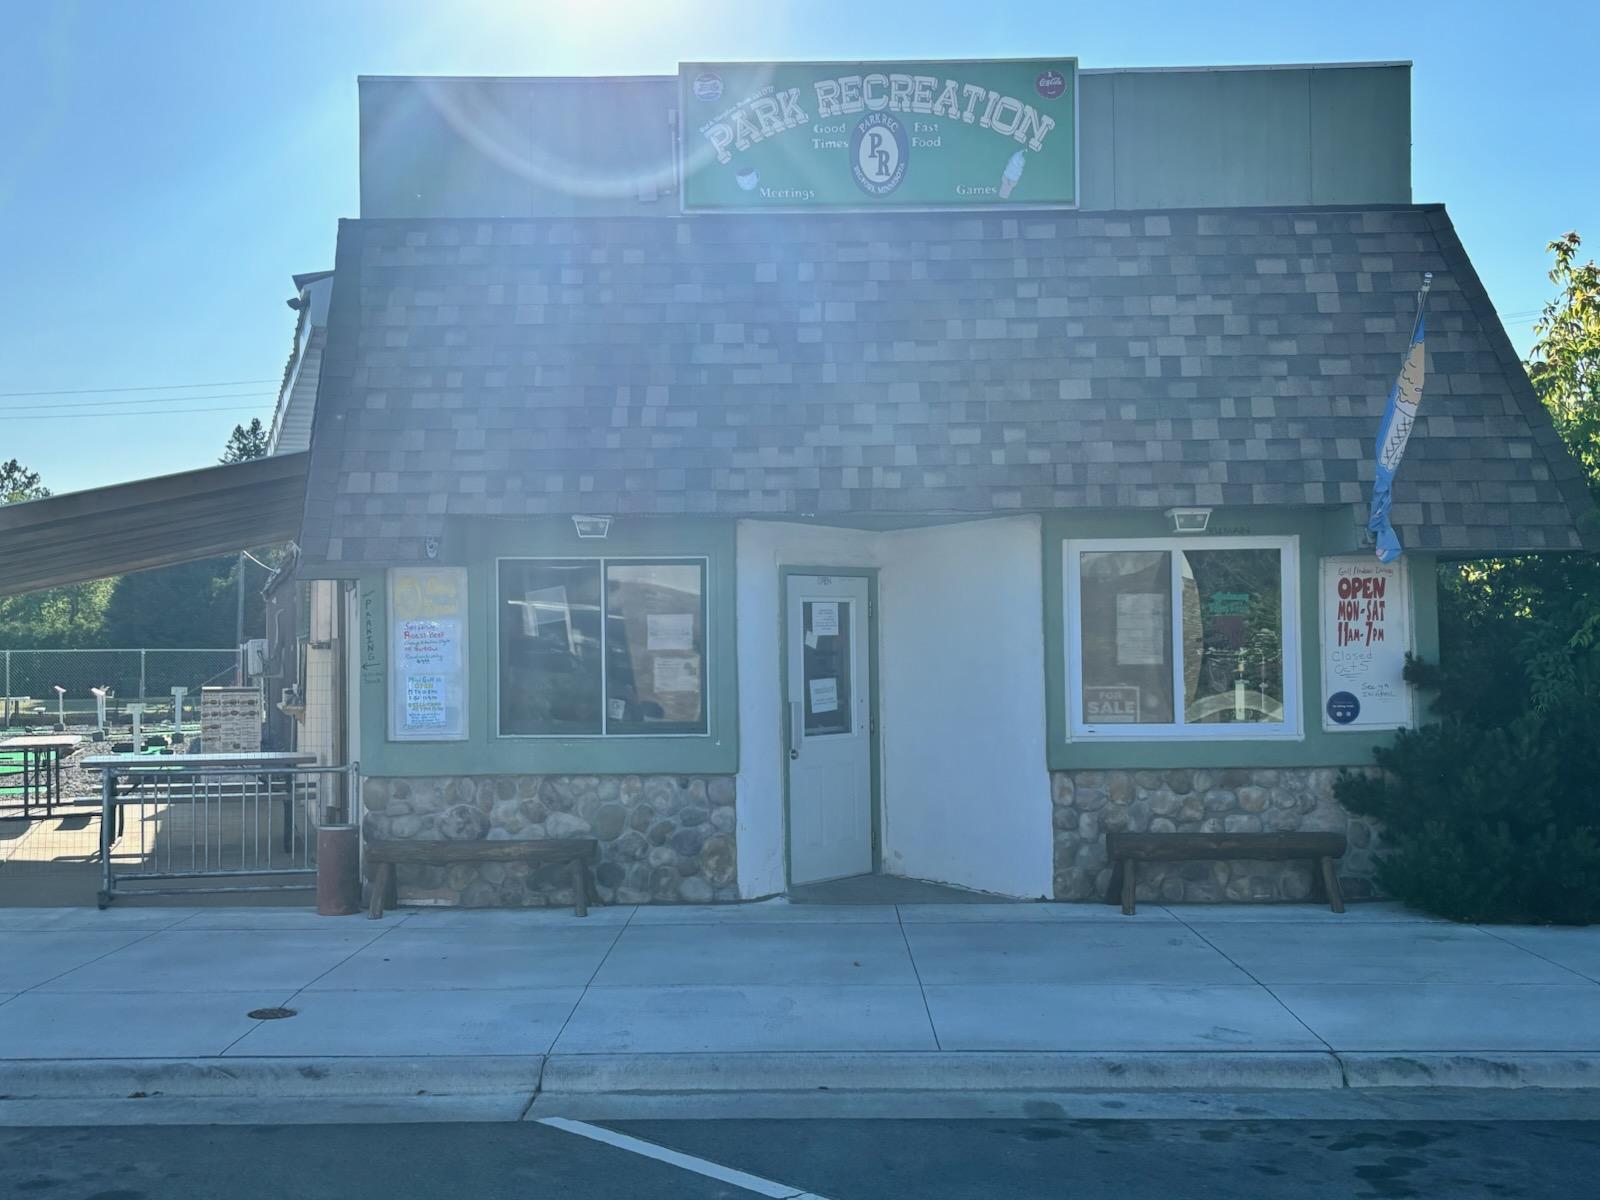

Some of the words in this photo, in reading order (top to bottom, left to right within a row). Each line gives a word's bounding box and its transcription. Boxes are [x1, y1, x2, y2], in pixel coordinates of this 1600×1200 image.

[704, 87, 808, 164] PARK
[814, 73, 1055, 152] RECREATION
[859, 113, 880, 132] PARK
[882, 113, 898, 132] REC
[813, 123, 846, 133] Good
[914, 122, 939, 132] Fast
[812, 139, 849, 149] Times
[912, 137, 942, 147] Food
[760, 187, 815, 200] Meetings
[956, 184, 1000, 195] Games
[1338, 577, 1385, 599] OPEN
[1338, 600, 1385, 621] MON-SAT
[365, 599, 375, 661] PARKING
[1338, 622, 1384, 646] 11AM-7PM
[1099, 691, 1121, 700] FOR
[1087, 701, 1135, 714] SALE
